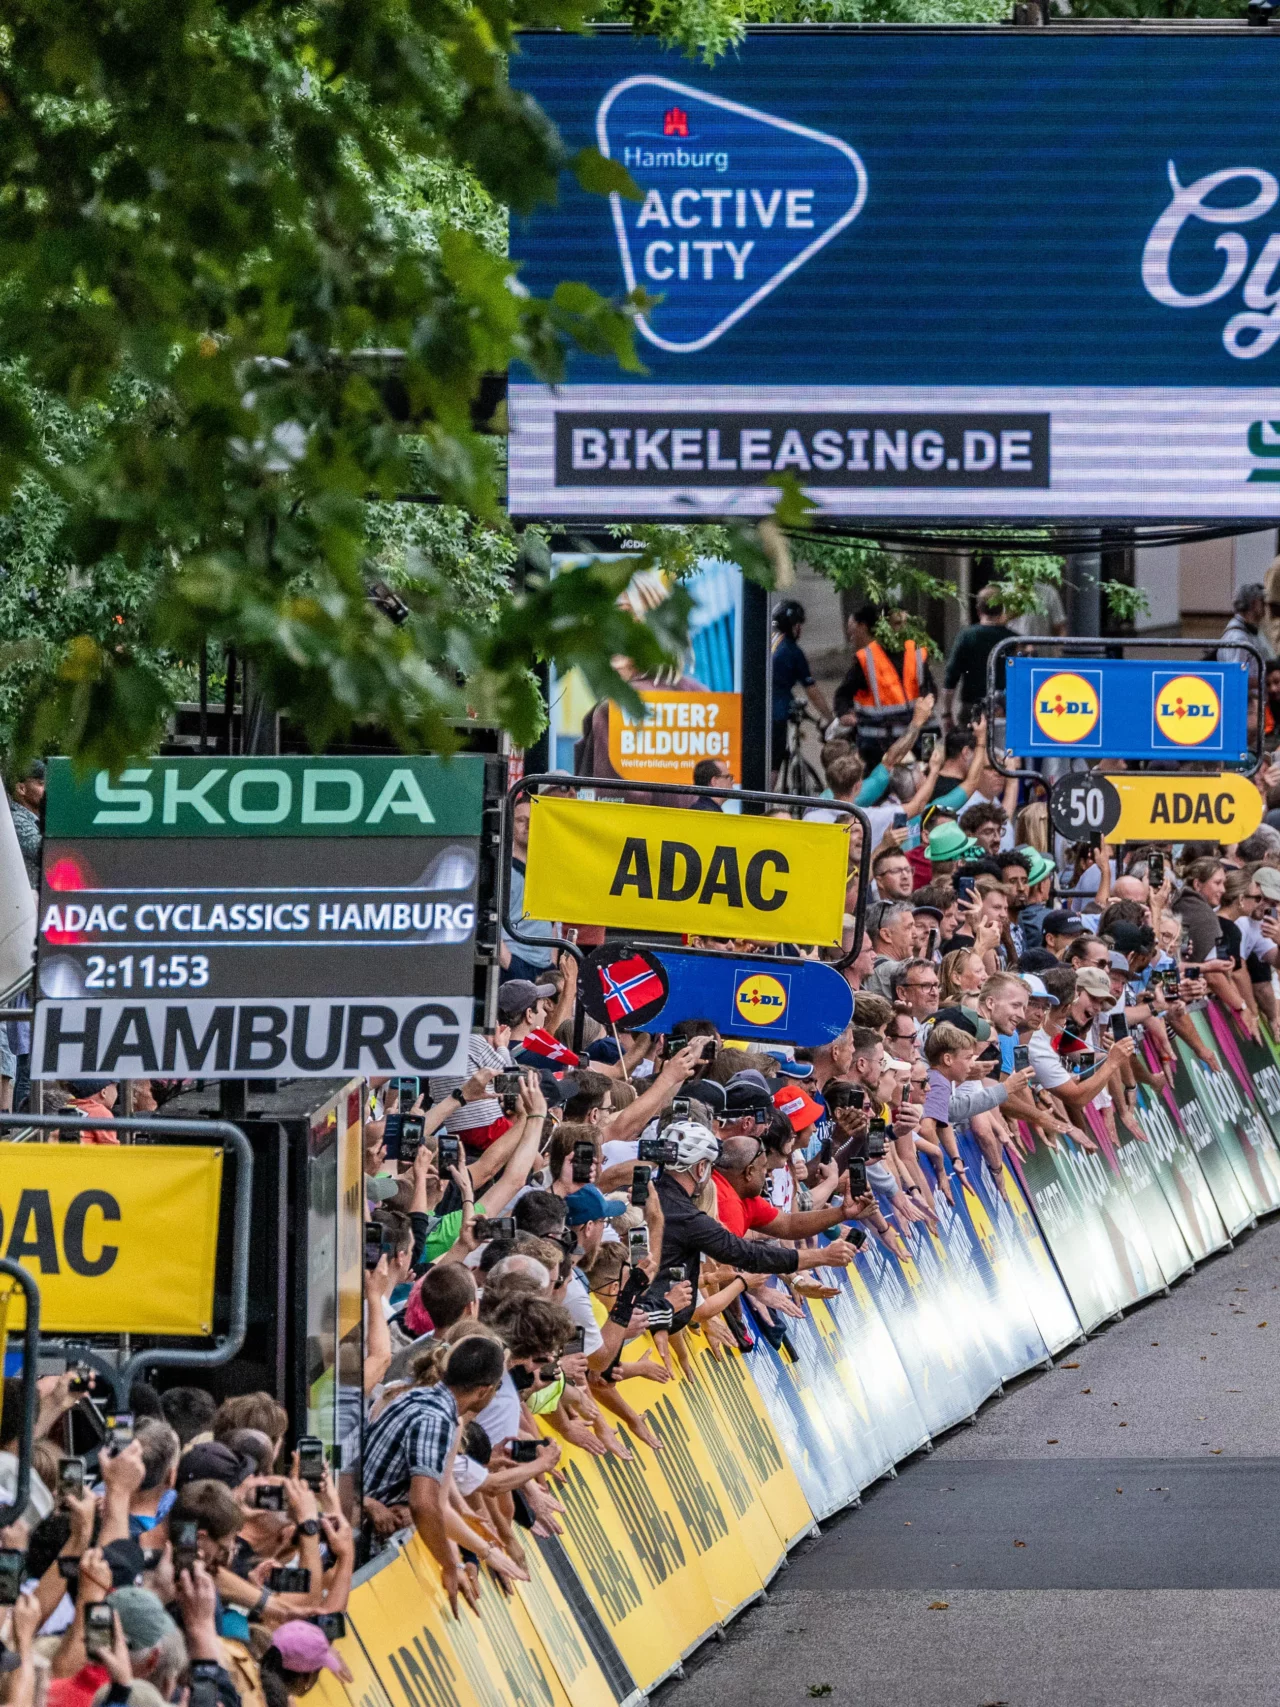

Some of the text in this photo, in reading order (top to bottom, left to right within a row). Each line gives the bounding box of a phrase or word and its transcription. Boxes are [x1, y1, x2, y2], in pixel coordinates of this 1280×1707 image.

[624, 147, 728, 171] Hamburg
[637, 190, 814, 229] ACTIVE
[645, 242, 754, 280] CITY
[572, 428, 1033, 471] BIKELEASING.DE
[621, 731, 729, 755] BILDUNG!
[1070, 788, 1104, 826] 50
[1150, 792, 1235, 824] ADAC
[609, 837, 790, 911] ADAC
[42, 903, 475, 932] ADAC CYCLASSICS HAMBURG
[85, 956, 209, 988] 2:11:53
[41, 1004, 461, 1073] HAMBURG
[0, 1189, 121, 1277] AC
